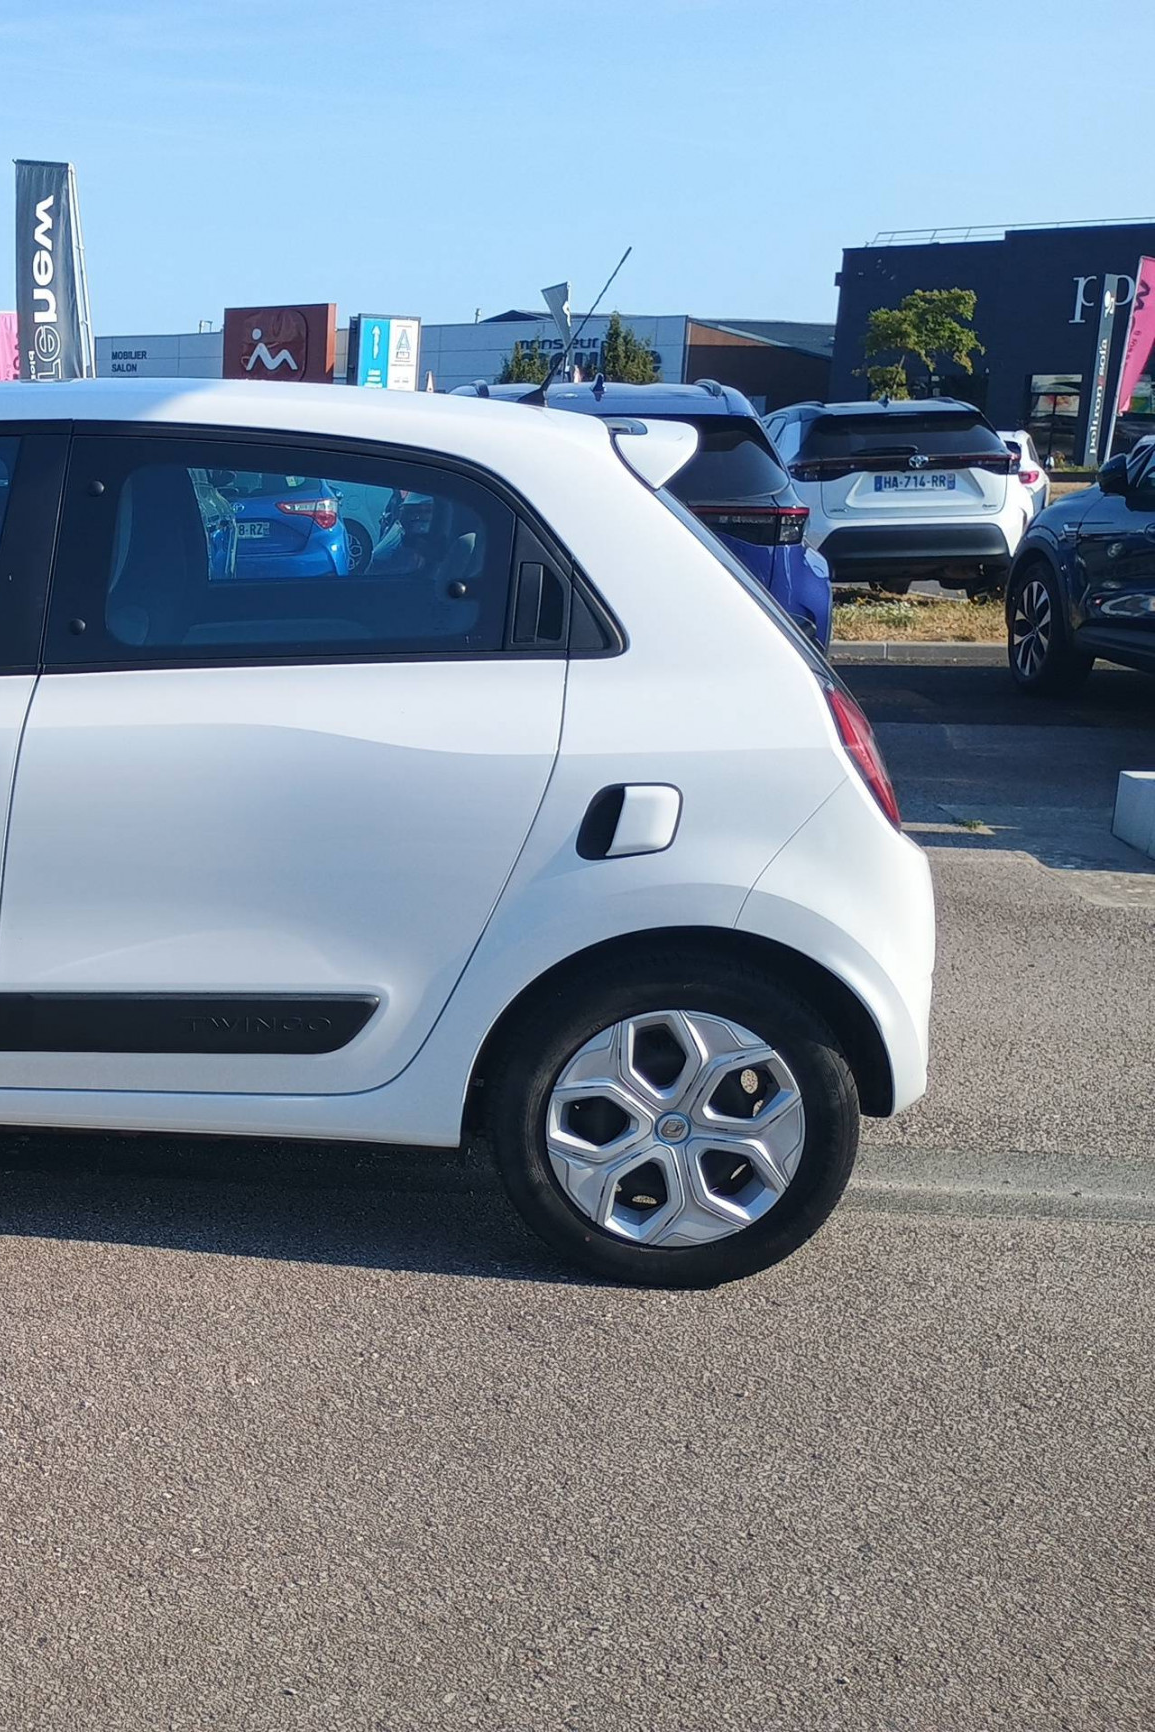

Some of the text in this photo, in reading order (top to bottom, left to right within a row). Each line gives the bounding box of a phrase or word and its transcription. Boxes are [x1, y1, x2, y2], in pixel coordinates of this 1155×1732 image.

[518, 338, 600, 350] monseur
[111, 350, 147, 360] MOBILIER
[111, 363, 138, 372] SALON
[883, 475, 947, 489] HA-714-RR
[181, 1016, 332, 1033] TWINGO
